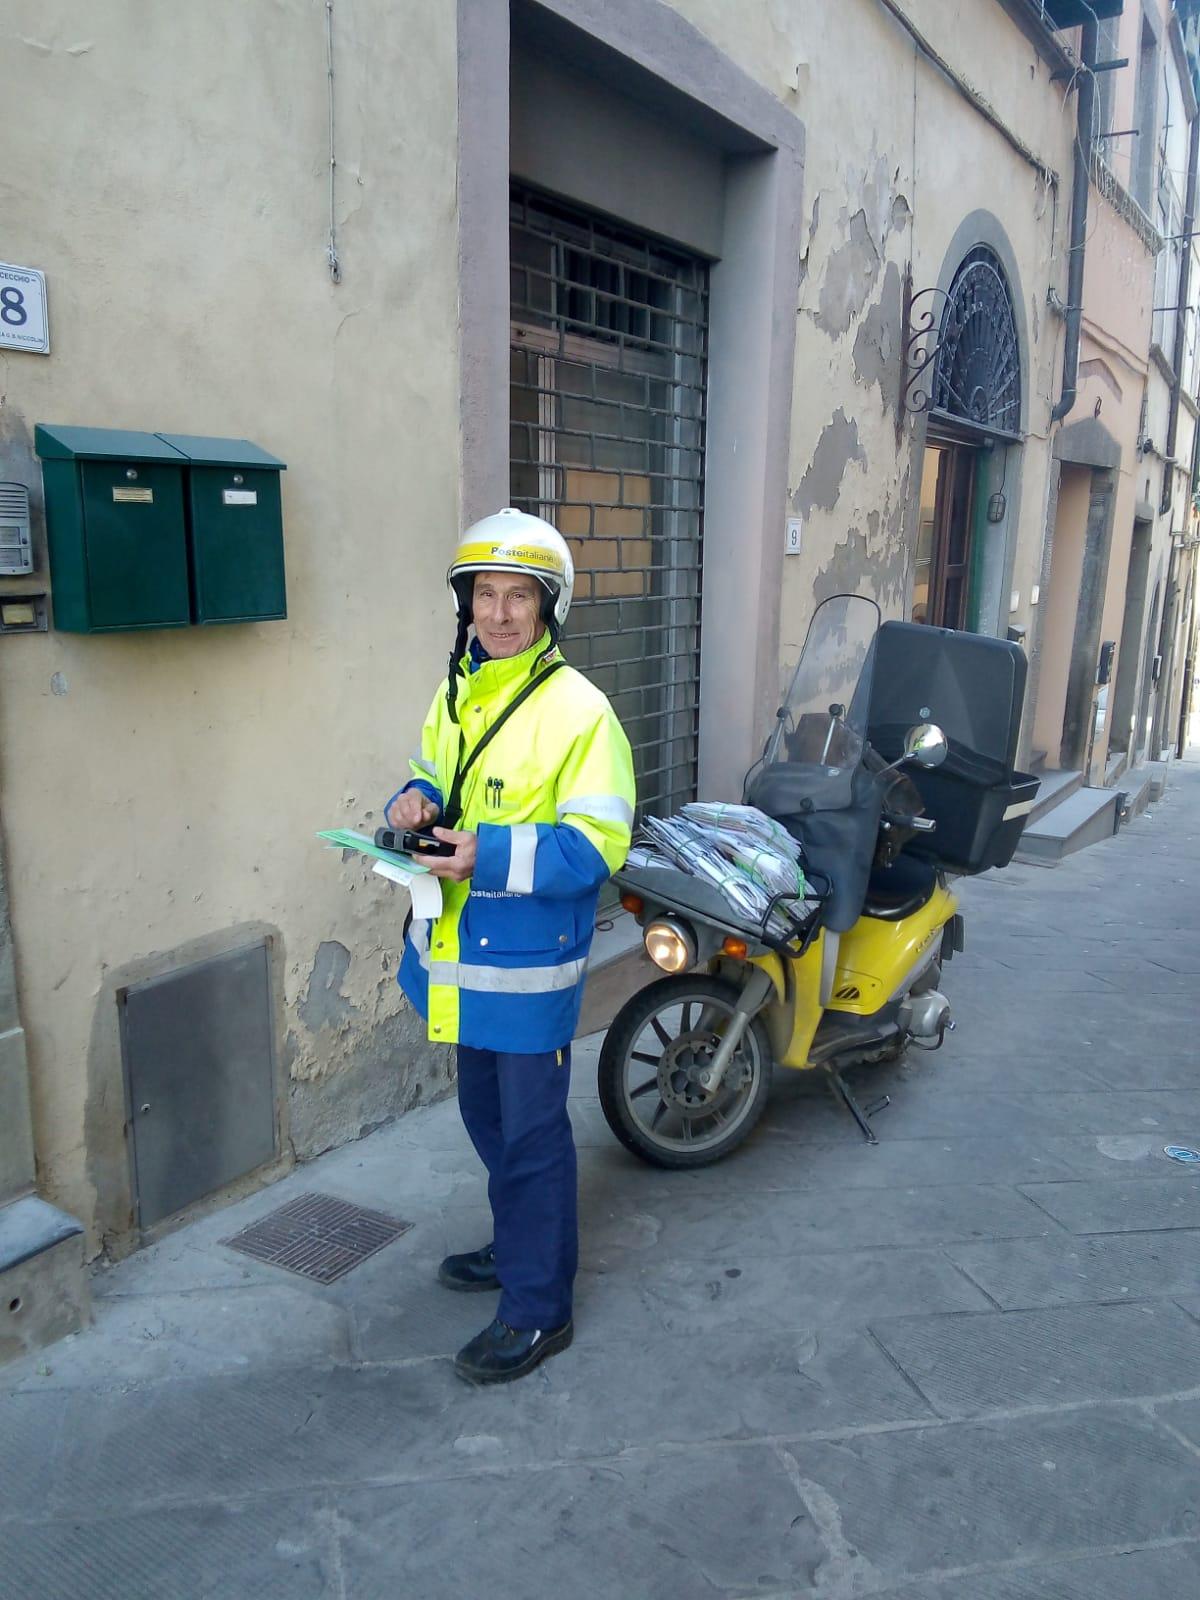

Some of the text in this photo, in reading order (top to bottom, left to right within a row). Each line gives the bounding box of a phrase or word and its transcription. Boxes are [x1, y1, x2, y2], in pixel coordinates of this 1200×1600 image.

[1, 286, 27, 326] 8
[791, 529, 797, 545] 9
[470, 890, 520, 898] osteitalian
